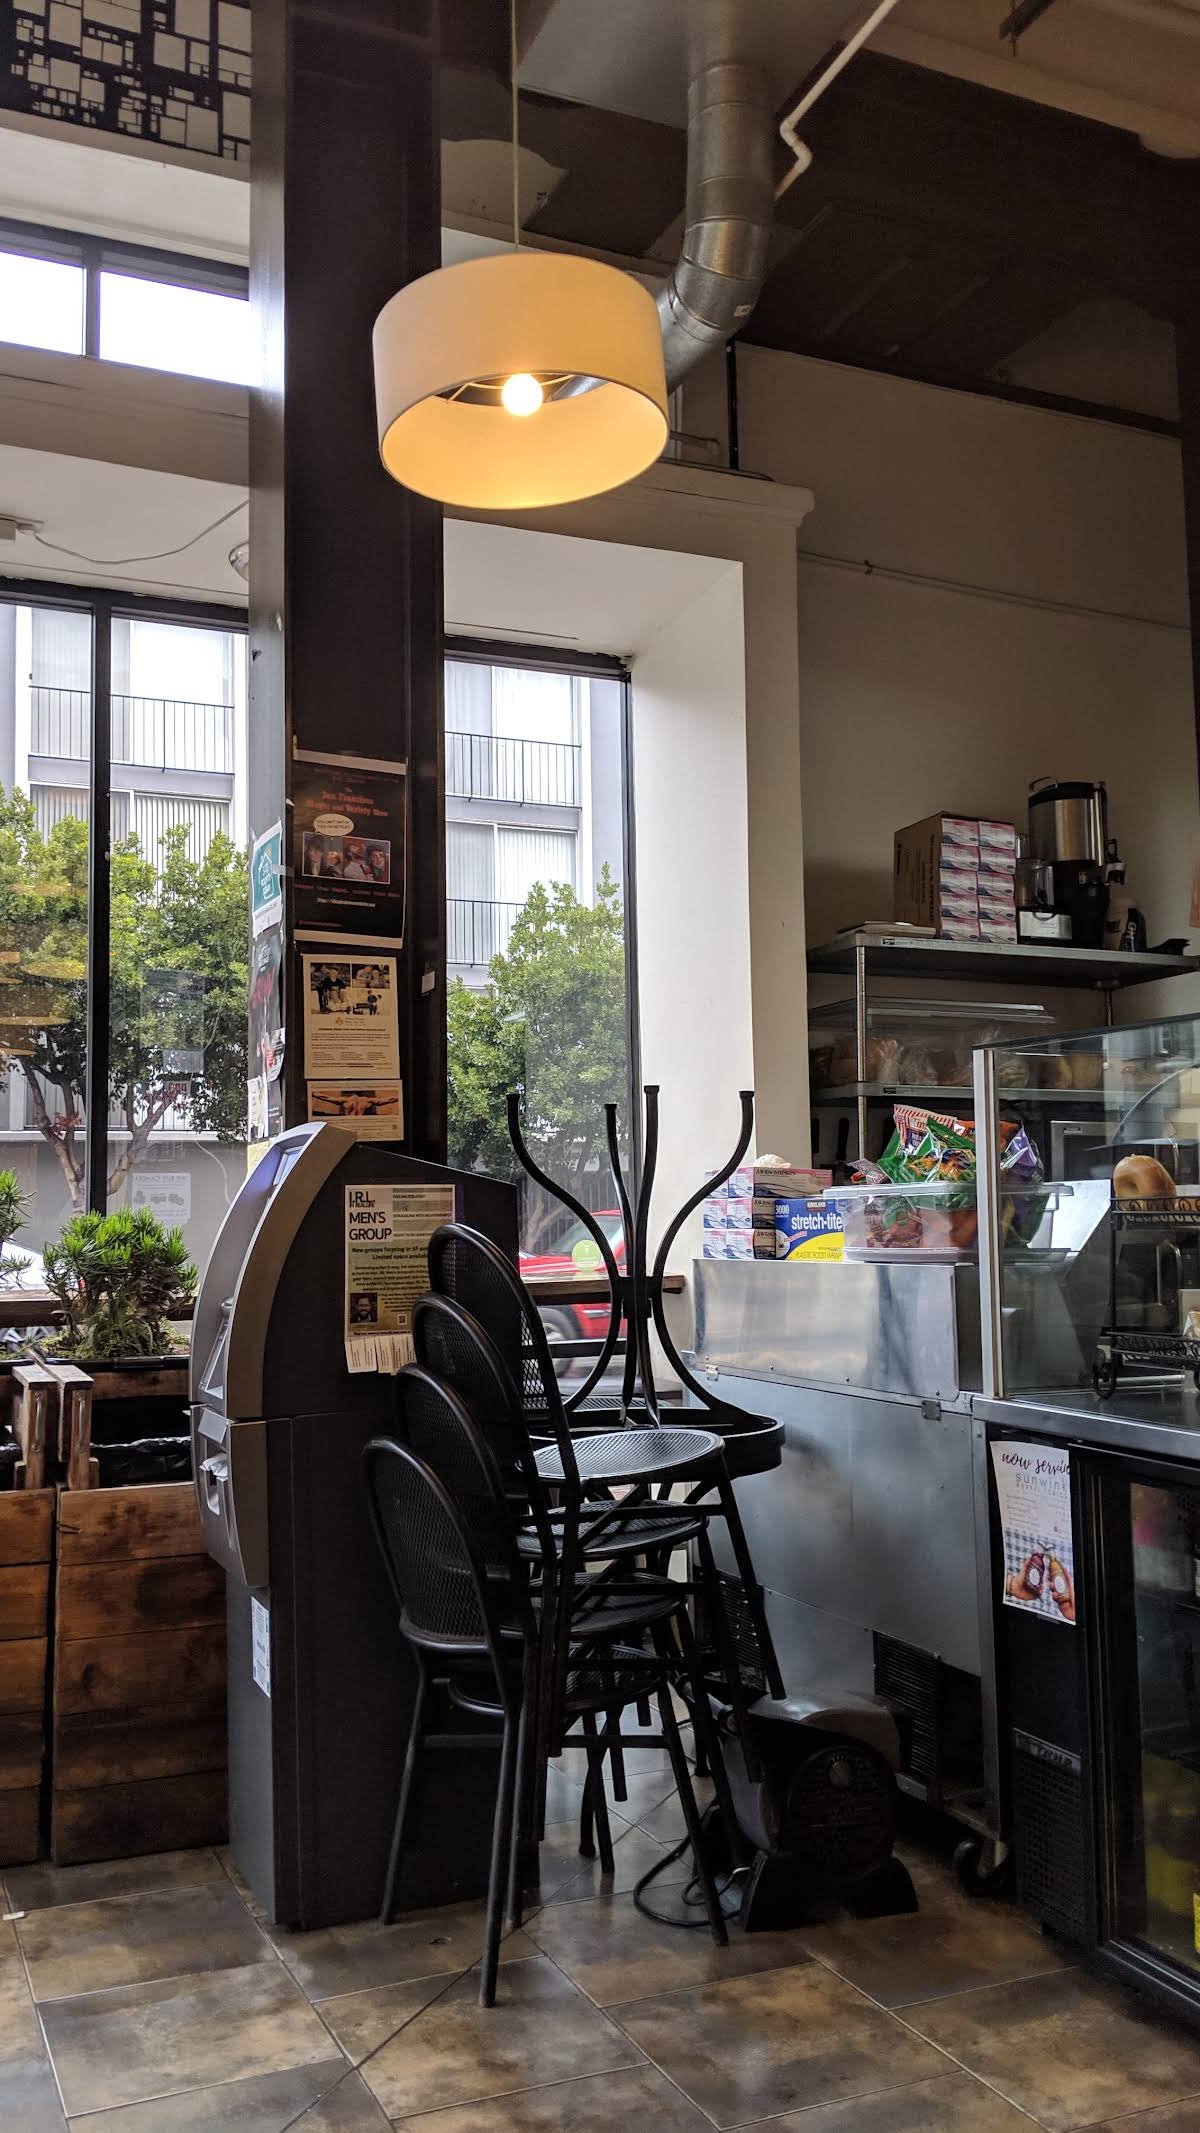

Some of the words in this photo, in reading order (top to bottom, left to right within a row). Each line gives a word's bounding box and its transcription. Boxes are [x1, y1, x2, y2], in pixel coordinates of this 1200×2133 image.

[349, 1211, 386, 1224] MEN'S
[791, 1213, 843, 1230] stretch-tite
[349, 1228, 392, 1240] GROUP
[1002, 1453, 1031, 1470] now
[1034, 1459, 1071, 1476] servin
